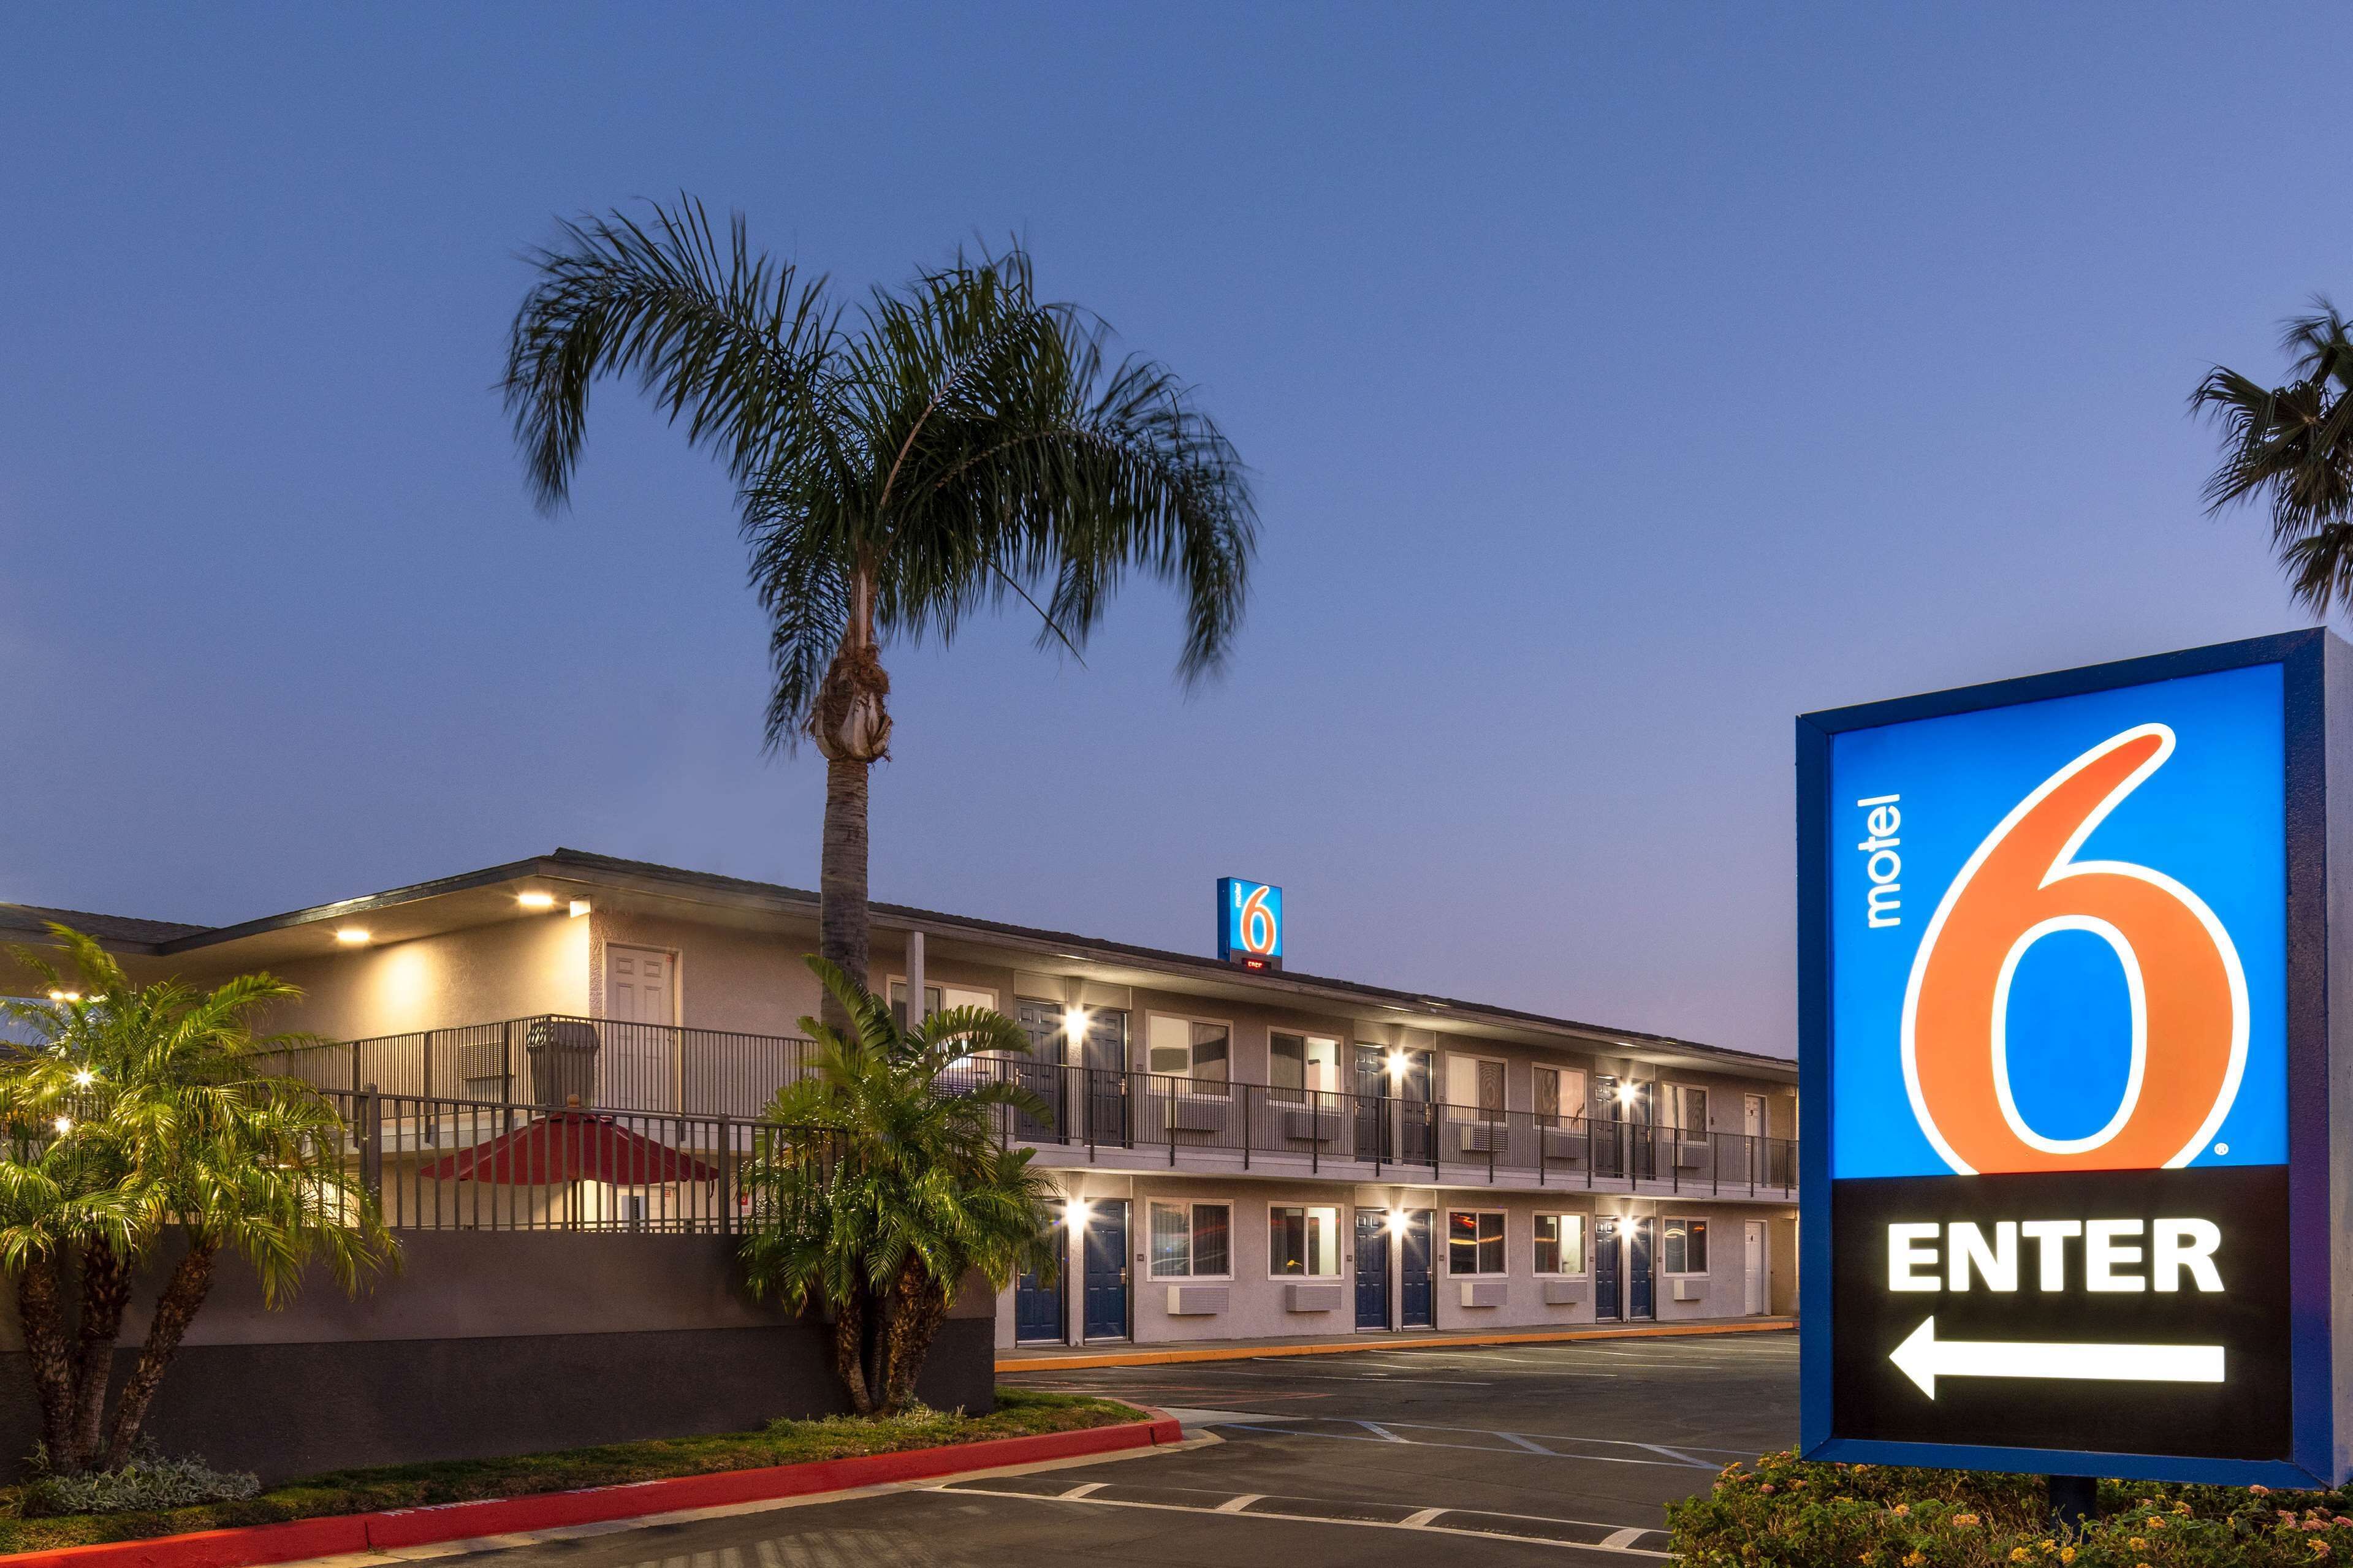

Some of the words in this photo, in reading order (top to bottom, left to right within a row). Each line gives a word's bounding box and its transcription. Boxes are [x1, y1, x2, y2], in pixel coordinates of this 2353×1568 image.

[1858, 795, 1901, 928] motel
[1241, 885, 1276, 955] 6
[1901, 723, 2249, 1175] 6
[1888, 1218, 2225, 1292] ENTER
